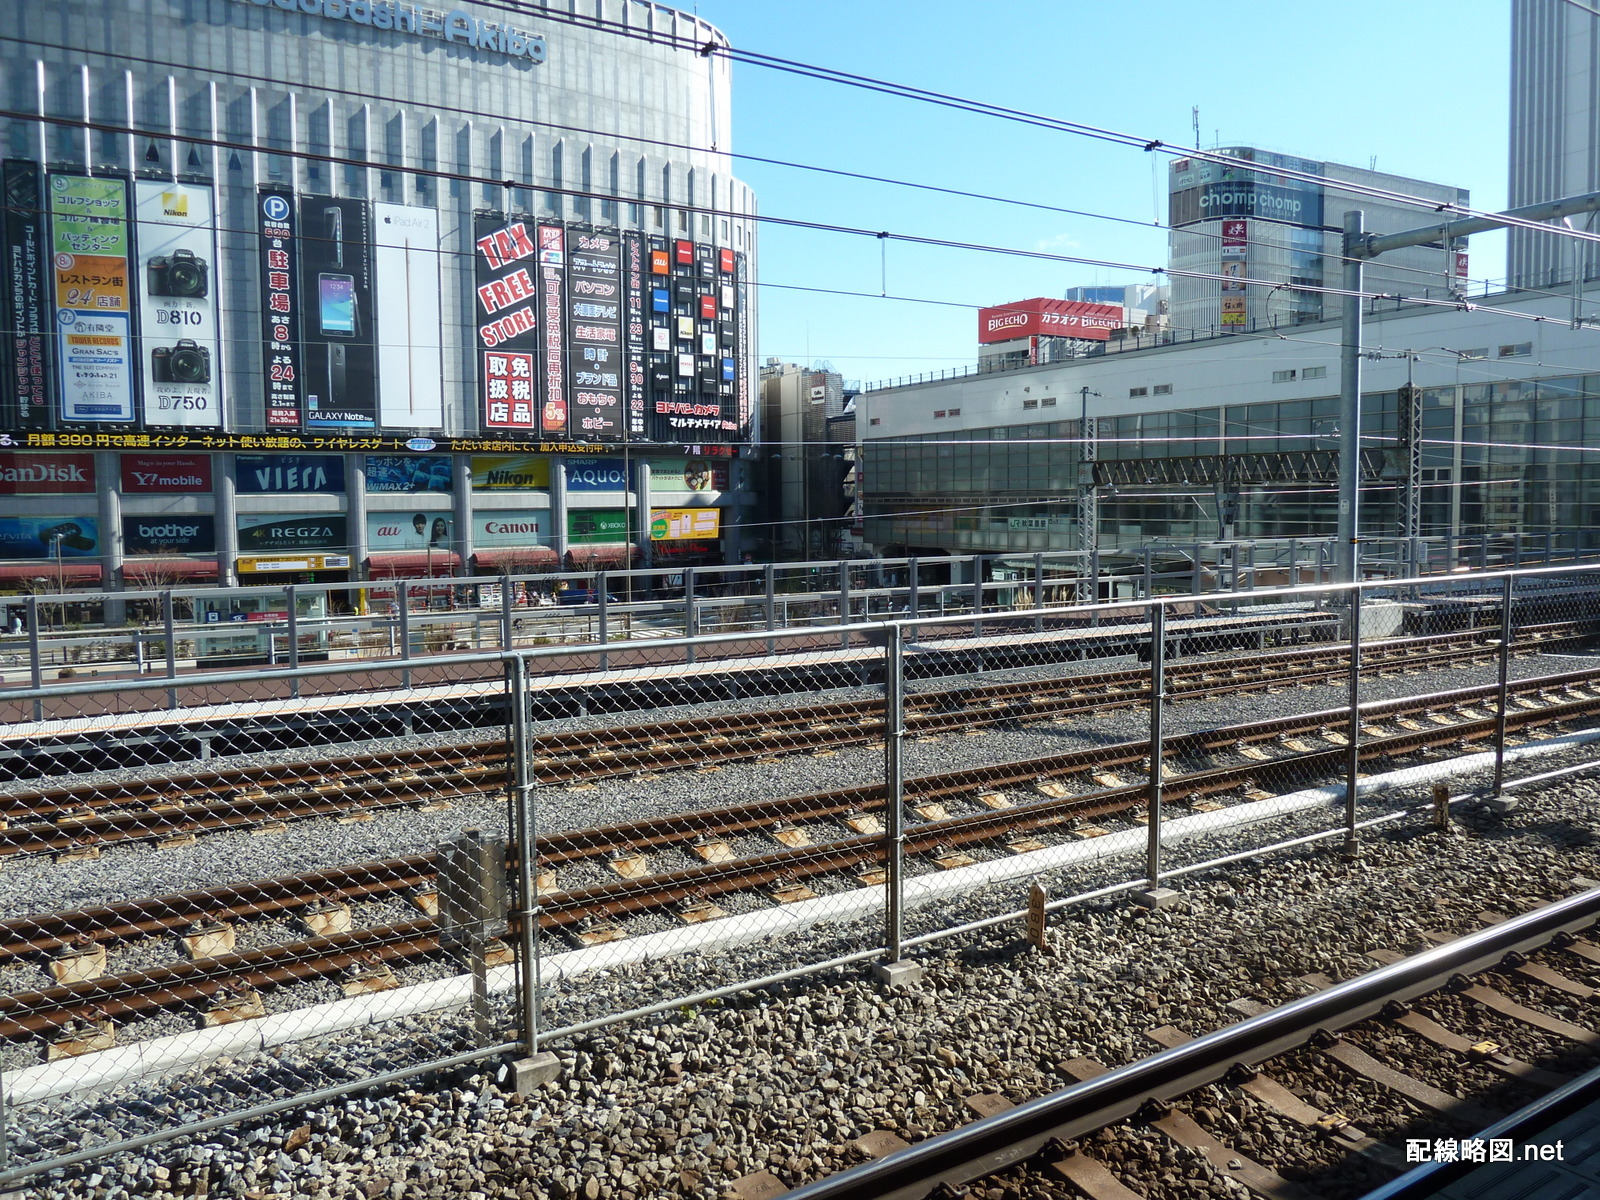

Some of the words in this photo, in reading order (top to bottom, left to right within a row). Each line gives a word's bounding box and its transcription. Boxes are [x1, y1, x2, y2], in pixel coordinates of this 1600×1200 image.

[57, 196, 120, 207] ゴルフショップ
[270, 199, 285, 217] P
[1199, 188, 1257, 210] chomp
[1259, 190, 1301, 217] chomp
[163, 208, 188, 217] Nikon
[393, 215, 411, 227] iPad
[411, 217, 423, 229] Air
[423, 219, 430, 229] 2
[61, 233, 119, 244] バッティング
[264, 228, 291, 239] 520
[70, 242, 111, 252] センター
[477, 222, 534, 271] TAX
[578, 236, 610, 251] カメラ
[630, 239, 641, 289] レストラン街
[653, 257, 668, 267] au
[60, 274, 123, 287] レストラン街
[268, 250, 291, 312] 駐車場
[478, 268, 535, 315] FREE
[574, 280, 616, 296] パソコン
[66, 288, 93, 305] 24
[97, 296, 121, 307] 店舗
[629, 298, 641, 308] 11
[156, 309, 202, 325] D810
[573, 303, 617, 319] 大画面テレビ
[271, 315, 290, 325] あさ
[480, 306, 536, 347] STORE
[988, 317, 1004, 331] BIG
[1004, 313, 1029, 326] ECHO
[1041, 311, 1079, 326] カラオケ
[1081, 315, 1098, 327] BIG
[1098, 319, 1121, 330] ECHO
[274, 325, 289, 341] 8
[575, 326, 616, 341] 生活家電
[629, 324, 643, 335] 23
[92, 336, 119, 346] RECORDS
[72, 347, 95, 355] GRAN
[583, 348, 609, 362] 時計
[272, 355, 292, 364] よる
[271, 365, 295, 381] 24
[576, 372, 618, 387] ブランド品
[630, 373, 644, 385] 30
[82, 391, 113, 399] AKIBA
[488, 356, 509, 423] 取扱店
[511, 356, 531, 423] 免税品
[158, 395, 207, 410] D750
[577, 392, 617, 406] おもちゃ
[630, 400, 644, 411] 22
[545, 402, 565, 420] 5%
[656, 401, 720, 416] ヨドバシカメラ
[308, 411, 342, 420] GALAXY
[344, 412, 364, 421] Note
[582, 417, 614, 429] ホビー
[669, 417, 721, 430] マルチメディア
[366, 456, 417, 467] ニッポンを、
[487, 470, 534, 485] Nikon
[571, 469, 630, 486] AQUOS
[366, 482, 401, 491] WiMAX
[402, 481, 416, 491] 2+
[139, 523, 199, 538] brother
[485, 521, 539, 534] Canon
[1010, 519, 1020, 528] JR
[252, 529, 266, 538] 4K
[271, 527, 334, 538] REGZA
[377, 526, 401, 537] au
